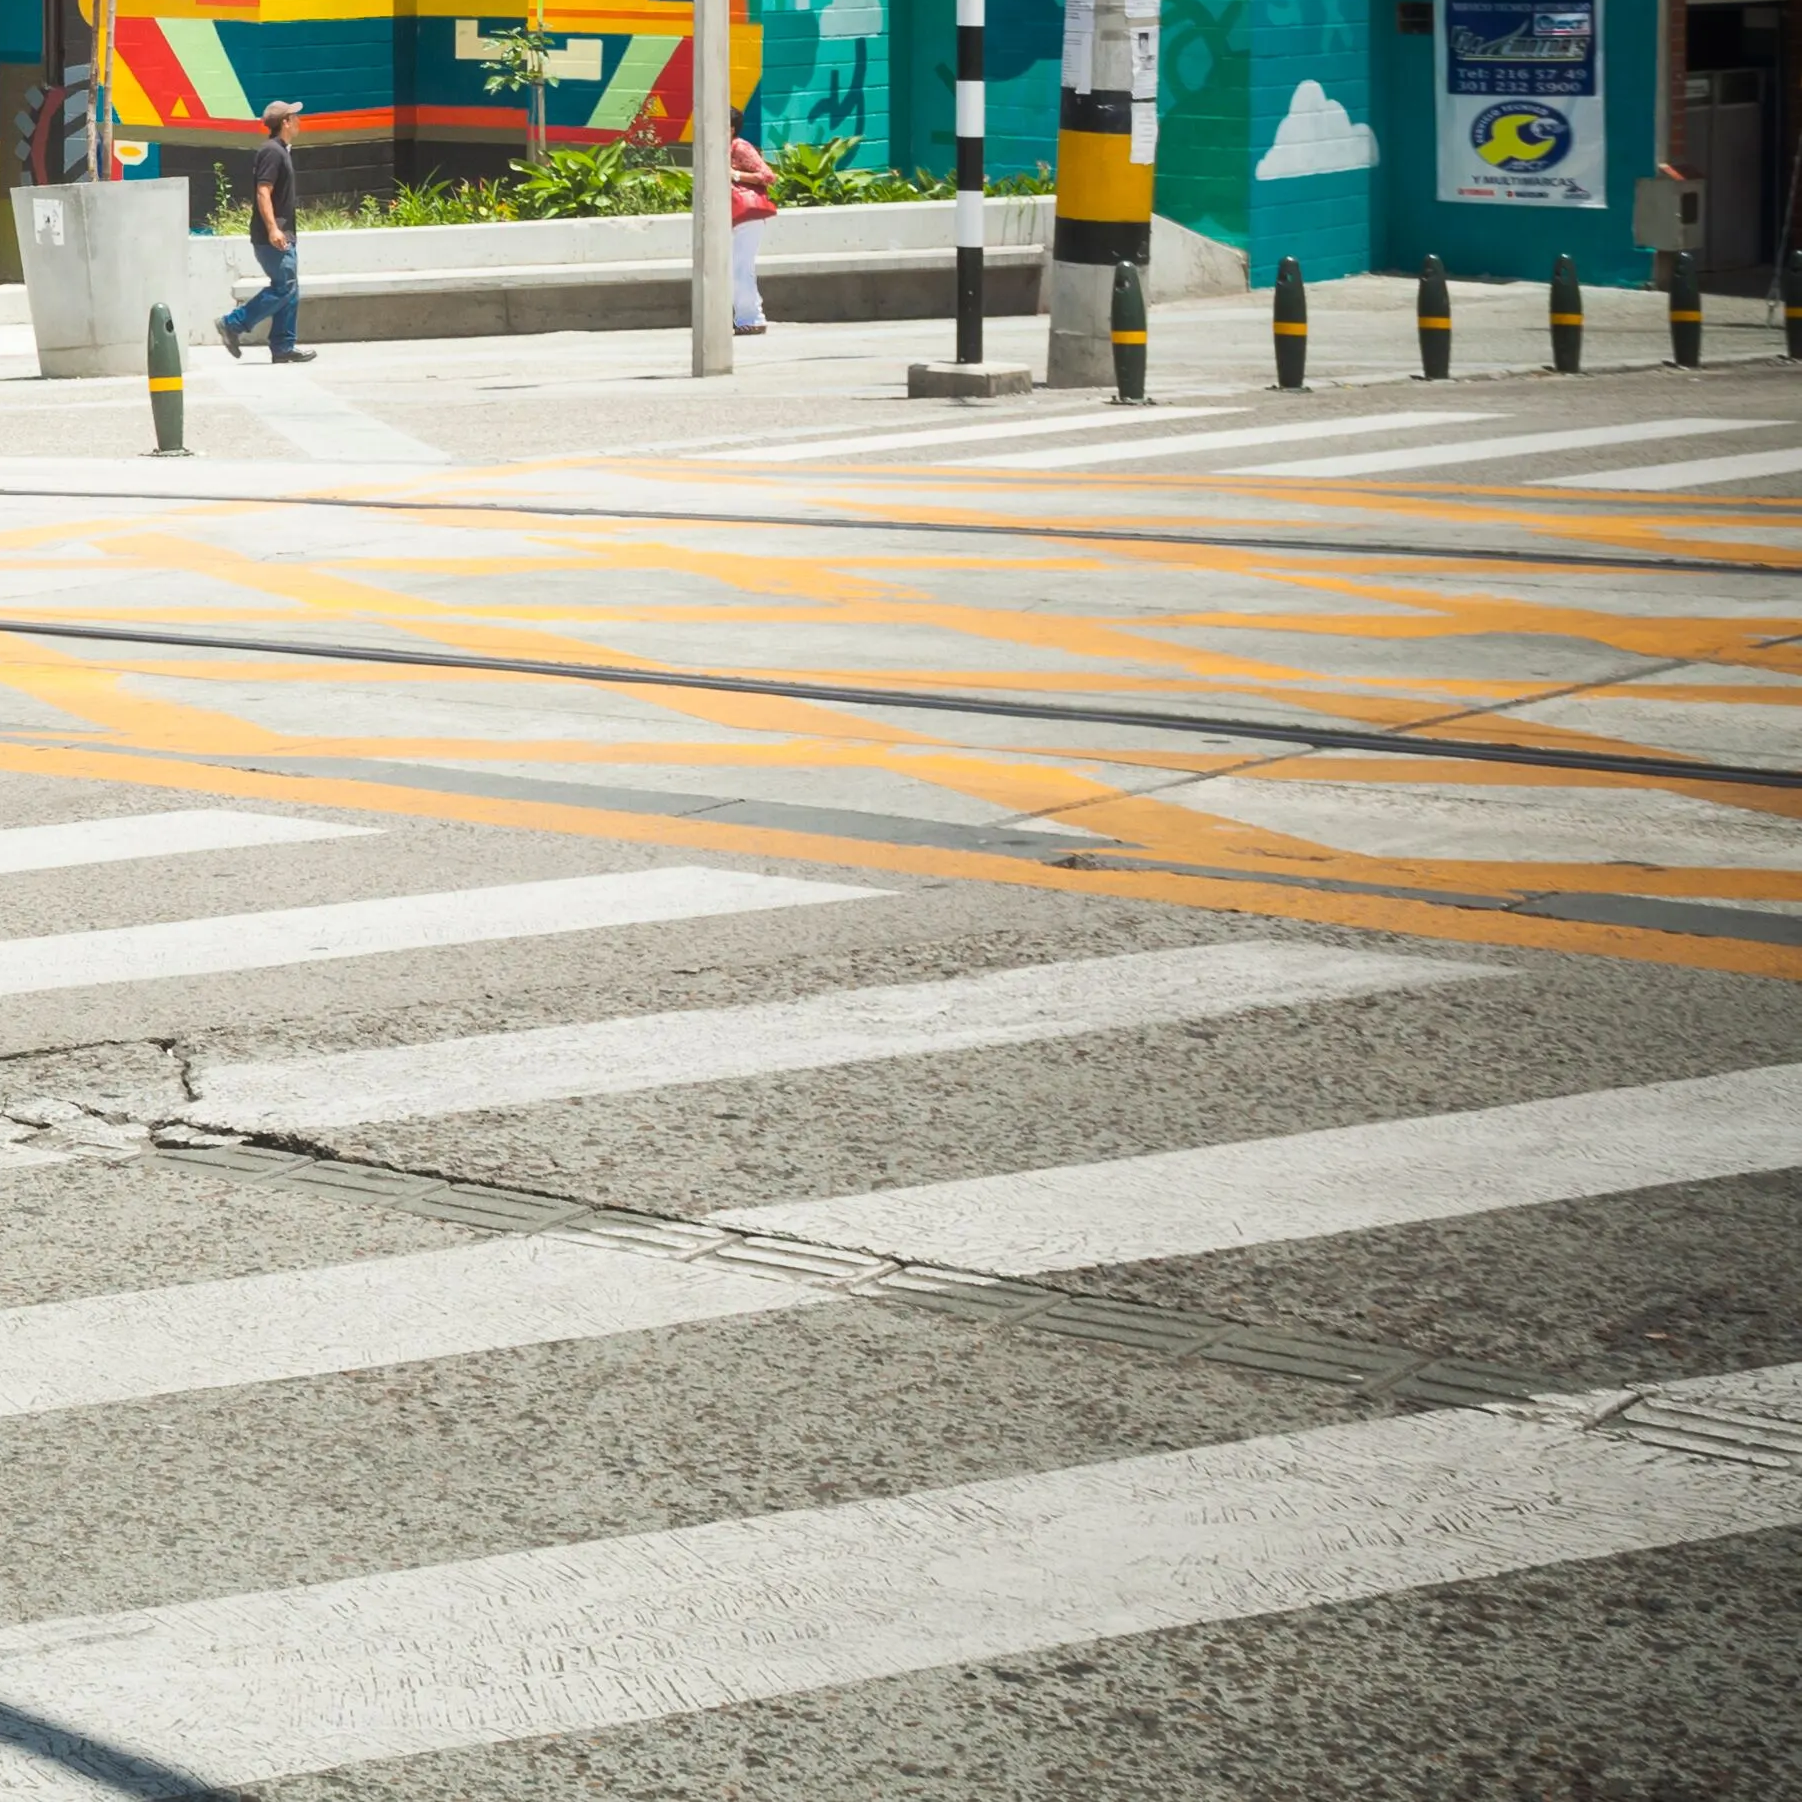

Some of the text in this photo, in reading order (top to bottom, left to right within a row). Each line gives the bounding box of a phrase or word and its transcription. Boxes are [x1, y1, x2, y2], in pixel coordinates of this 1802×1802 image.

[1495, 68, 1530, 80] 216
[1535, 68, 1558, 80] 57
[1456, 81, 1583, 93] 301 232 5900
